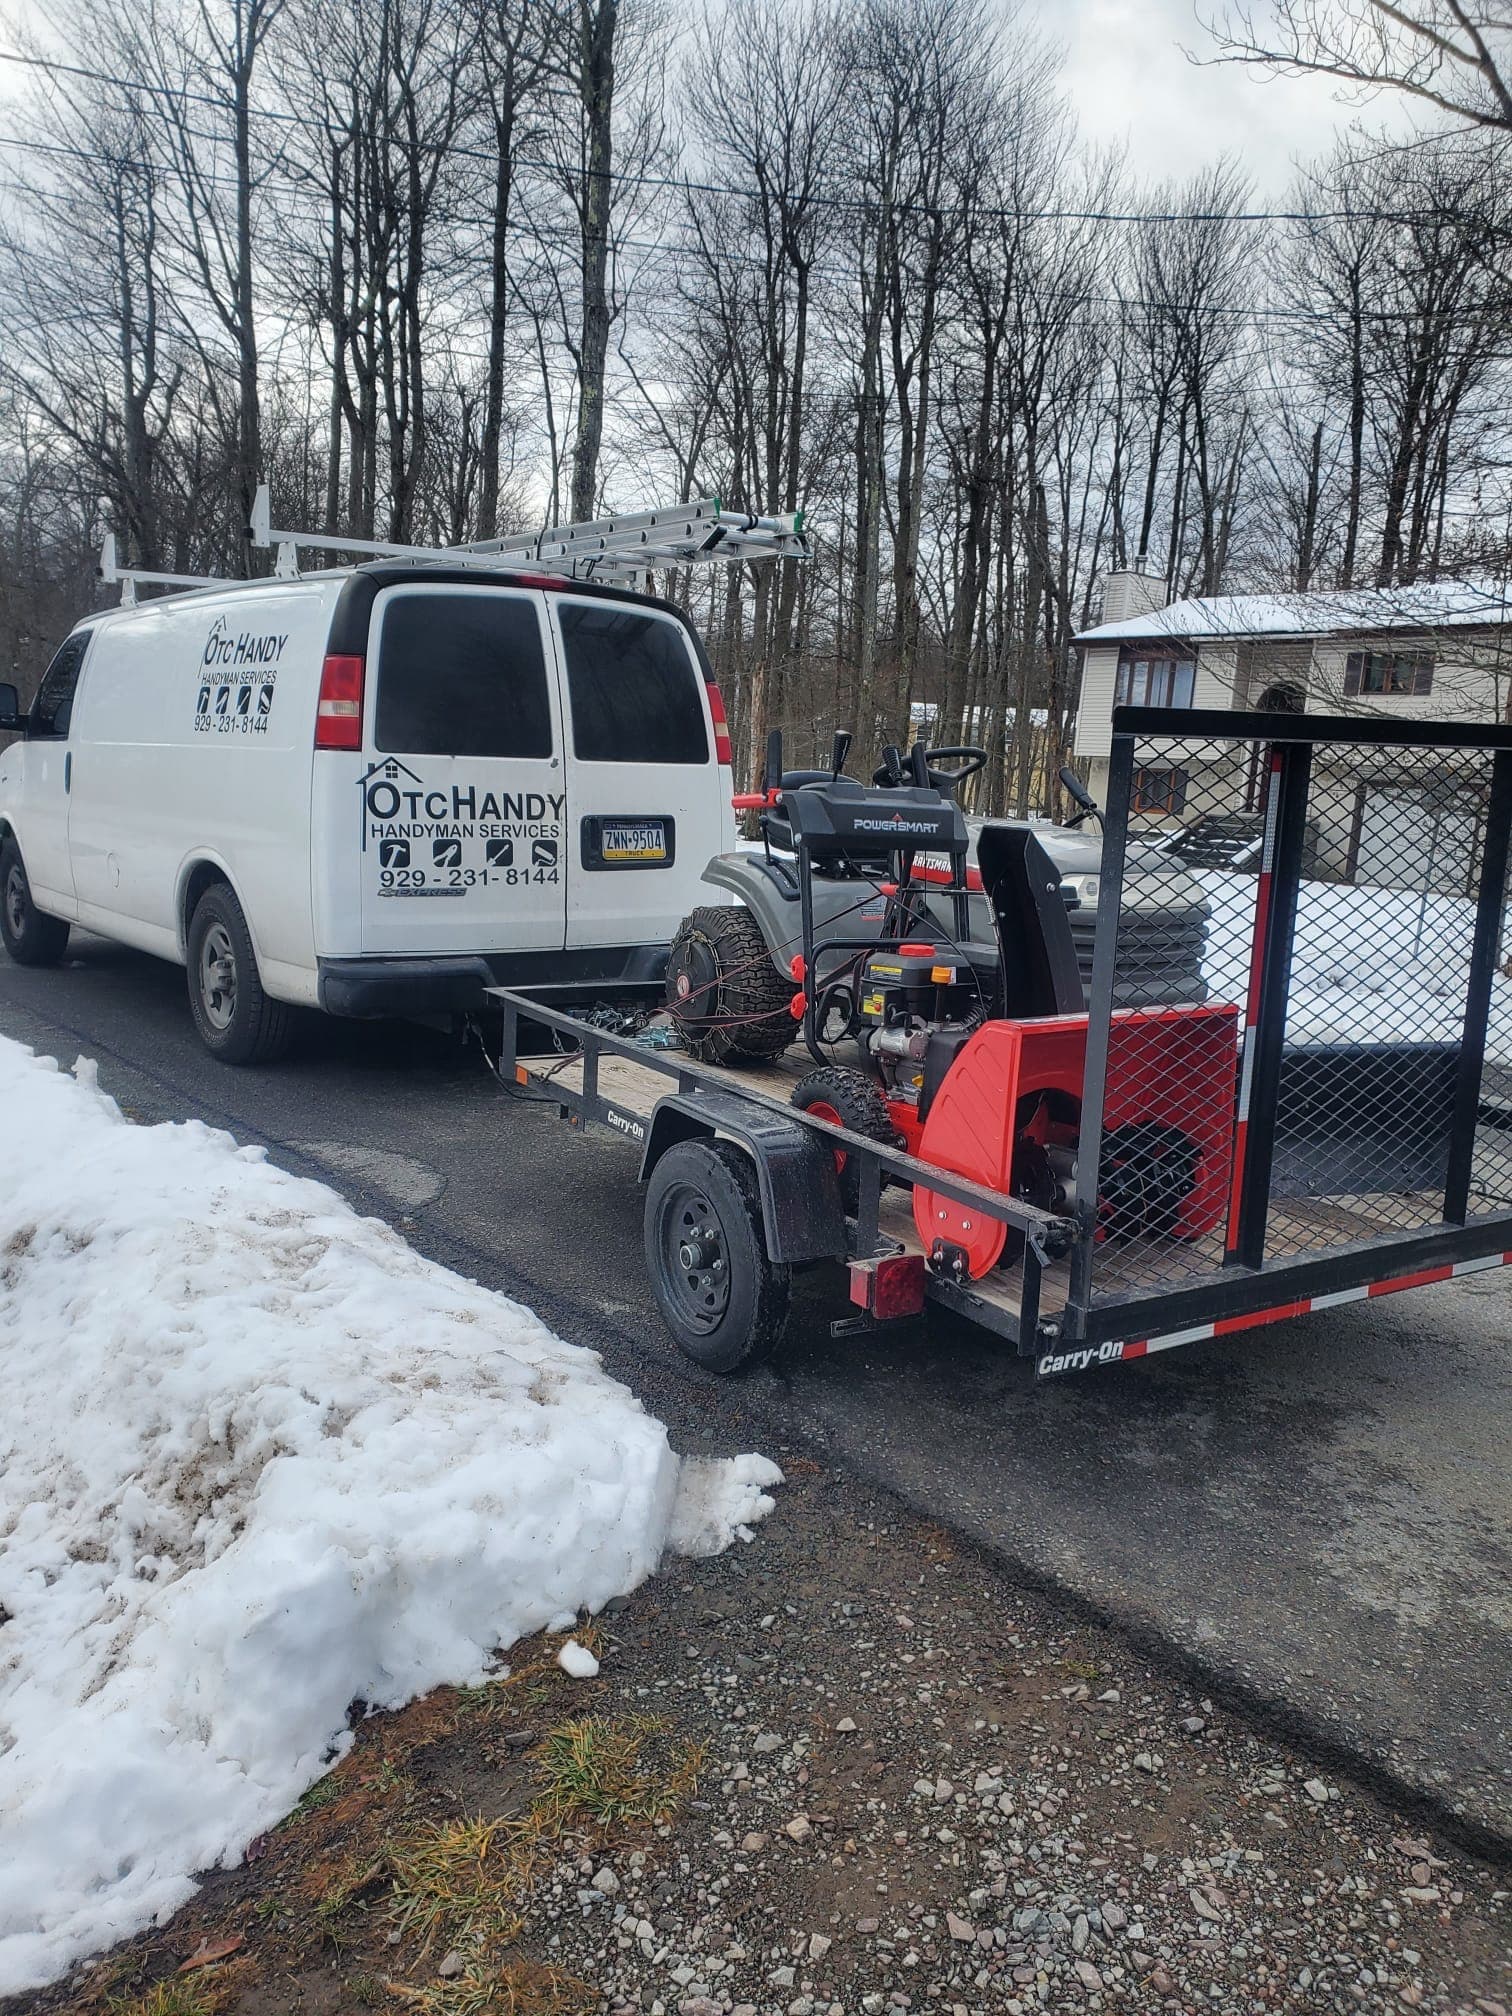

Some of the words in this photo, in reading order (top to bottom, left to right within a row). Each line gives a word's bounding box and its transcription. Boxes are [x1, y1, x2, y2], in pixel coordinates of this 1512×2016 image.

[201, 671, 240, 686] HANDYMAN
[239, 669, 278, 685] SERVICES
[371, 824, 474, 839] HANDYMAN
[479, 824, 560, 839] SERVICES
[853, 818, 939, 833] POWERSMART
[911, 854, 953, 873] RAFTSMAN
[394, 887, 468, 897] EXPRESS
[607, 1110, 644, 1139] Carry-On
[1039, 1340, 1125, 1375] Carry-On
